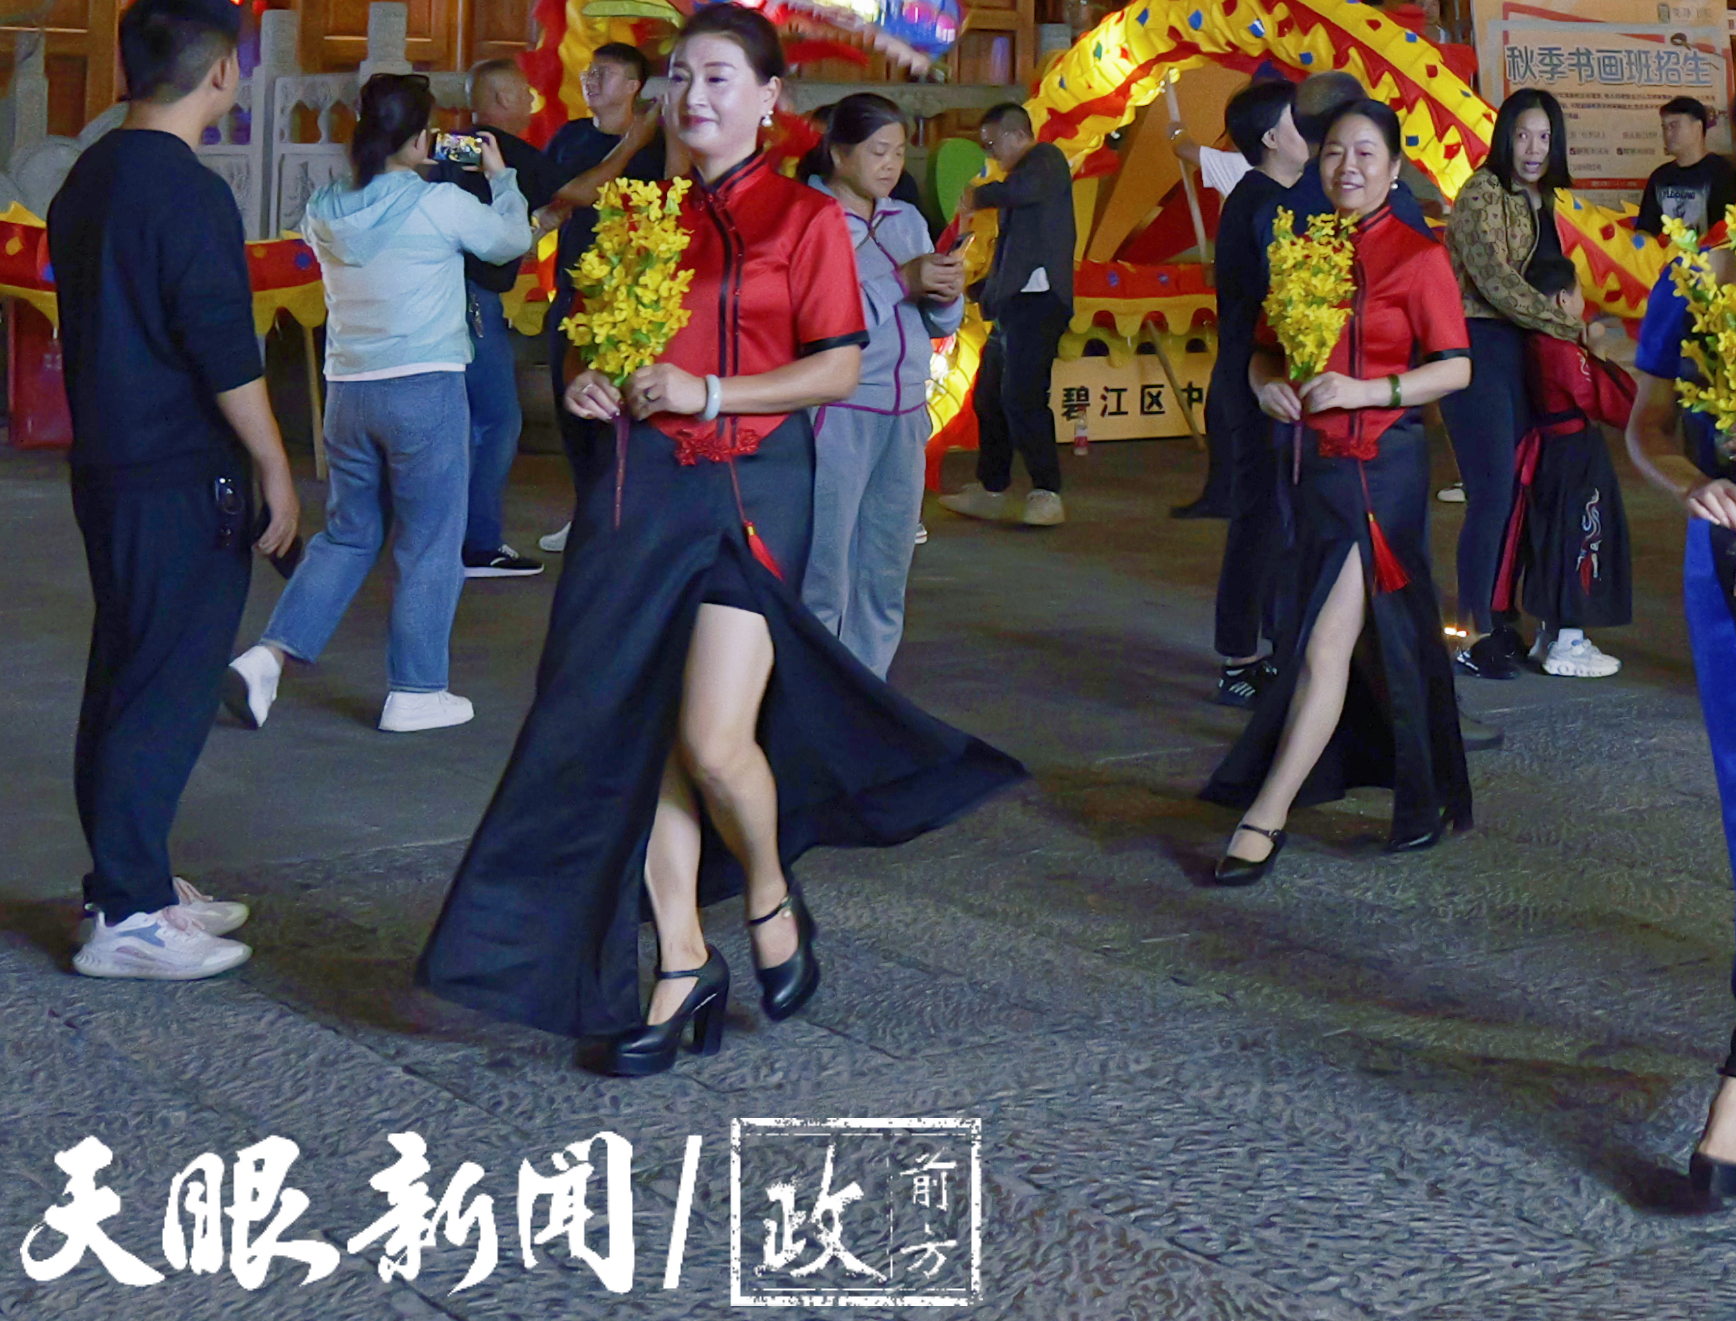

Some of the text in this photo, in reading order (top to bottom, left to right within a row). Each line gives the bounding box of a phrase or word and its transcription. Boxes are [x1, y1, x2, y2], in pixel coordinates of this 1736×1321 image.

[1506, 44, 1713, 86] 秋季书画班招生
